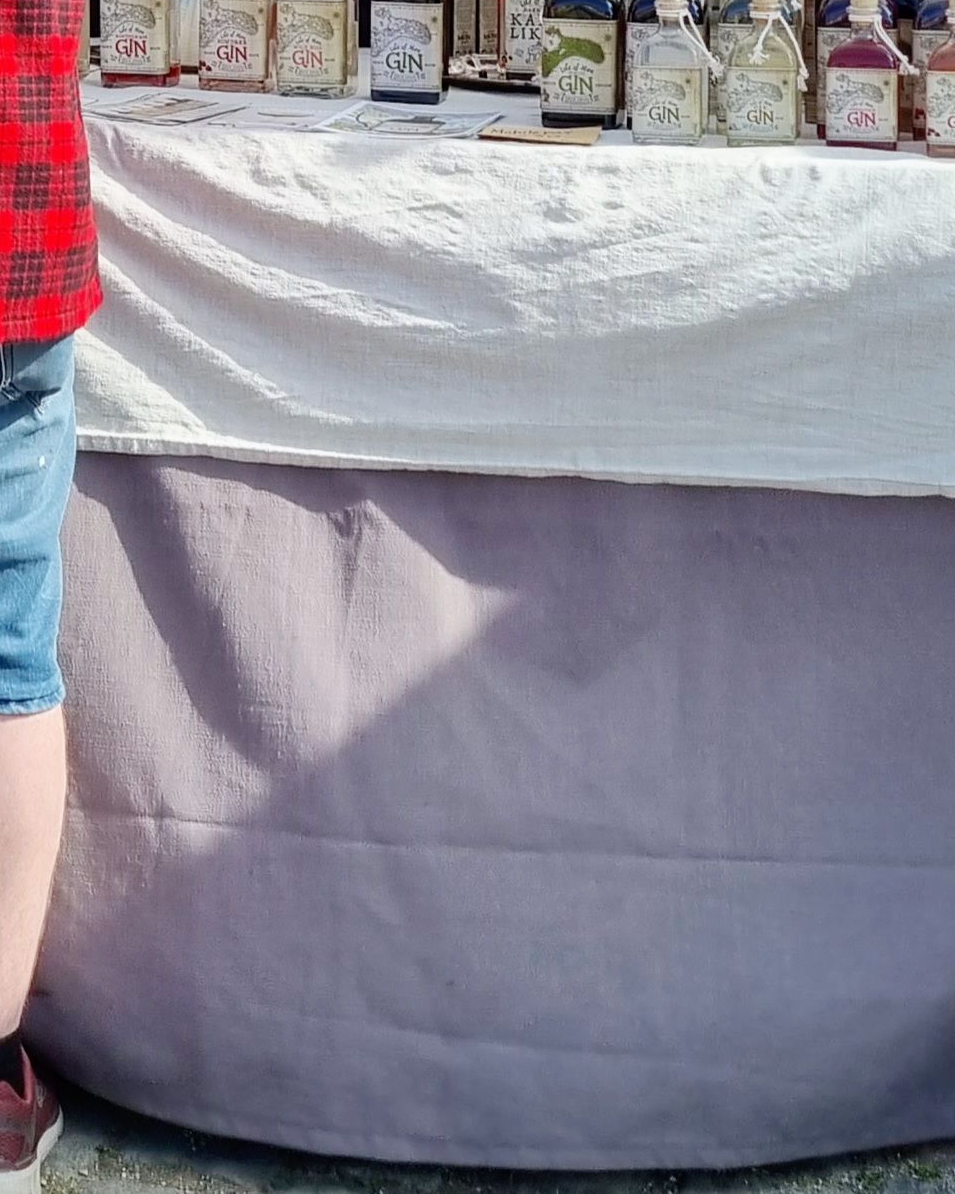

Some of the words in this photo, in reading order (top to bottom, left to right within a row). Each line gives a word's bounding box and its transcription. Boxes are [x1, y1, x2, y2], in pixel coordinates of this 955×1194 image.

[510, 13, 542, 26] KA
[115, 39, 147, 57] GIN
[216, 45, 248, 62] GIN
[292, 49, 324, 68] GIN
[386, 52, 424, 73] GIN
[558, 74, 594, 95] GIN
[649, 106, 680, 124] GIN
[747, 109, 774, 125] GIN
[847, 111, 876, 127] GIN
